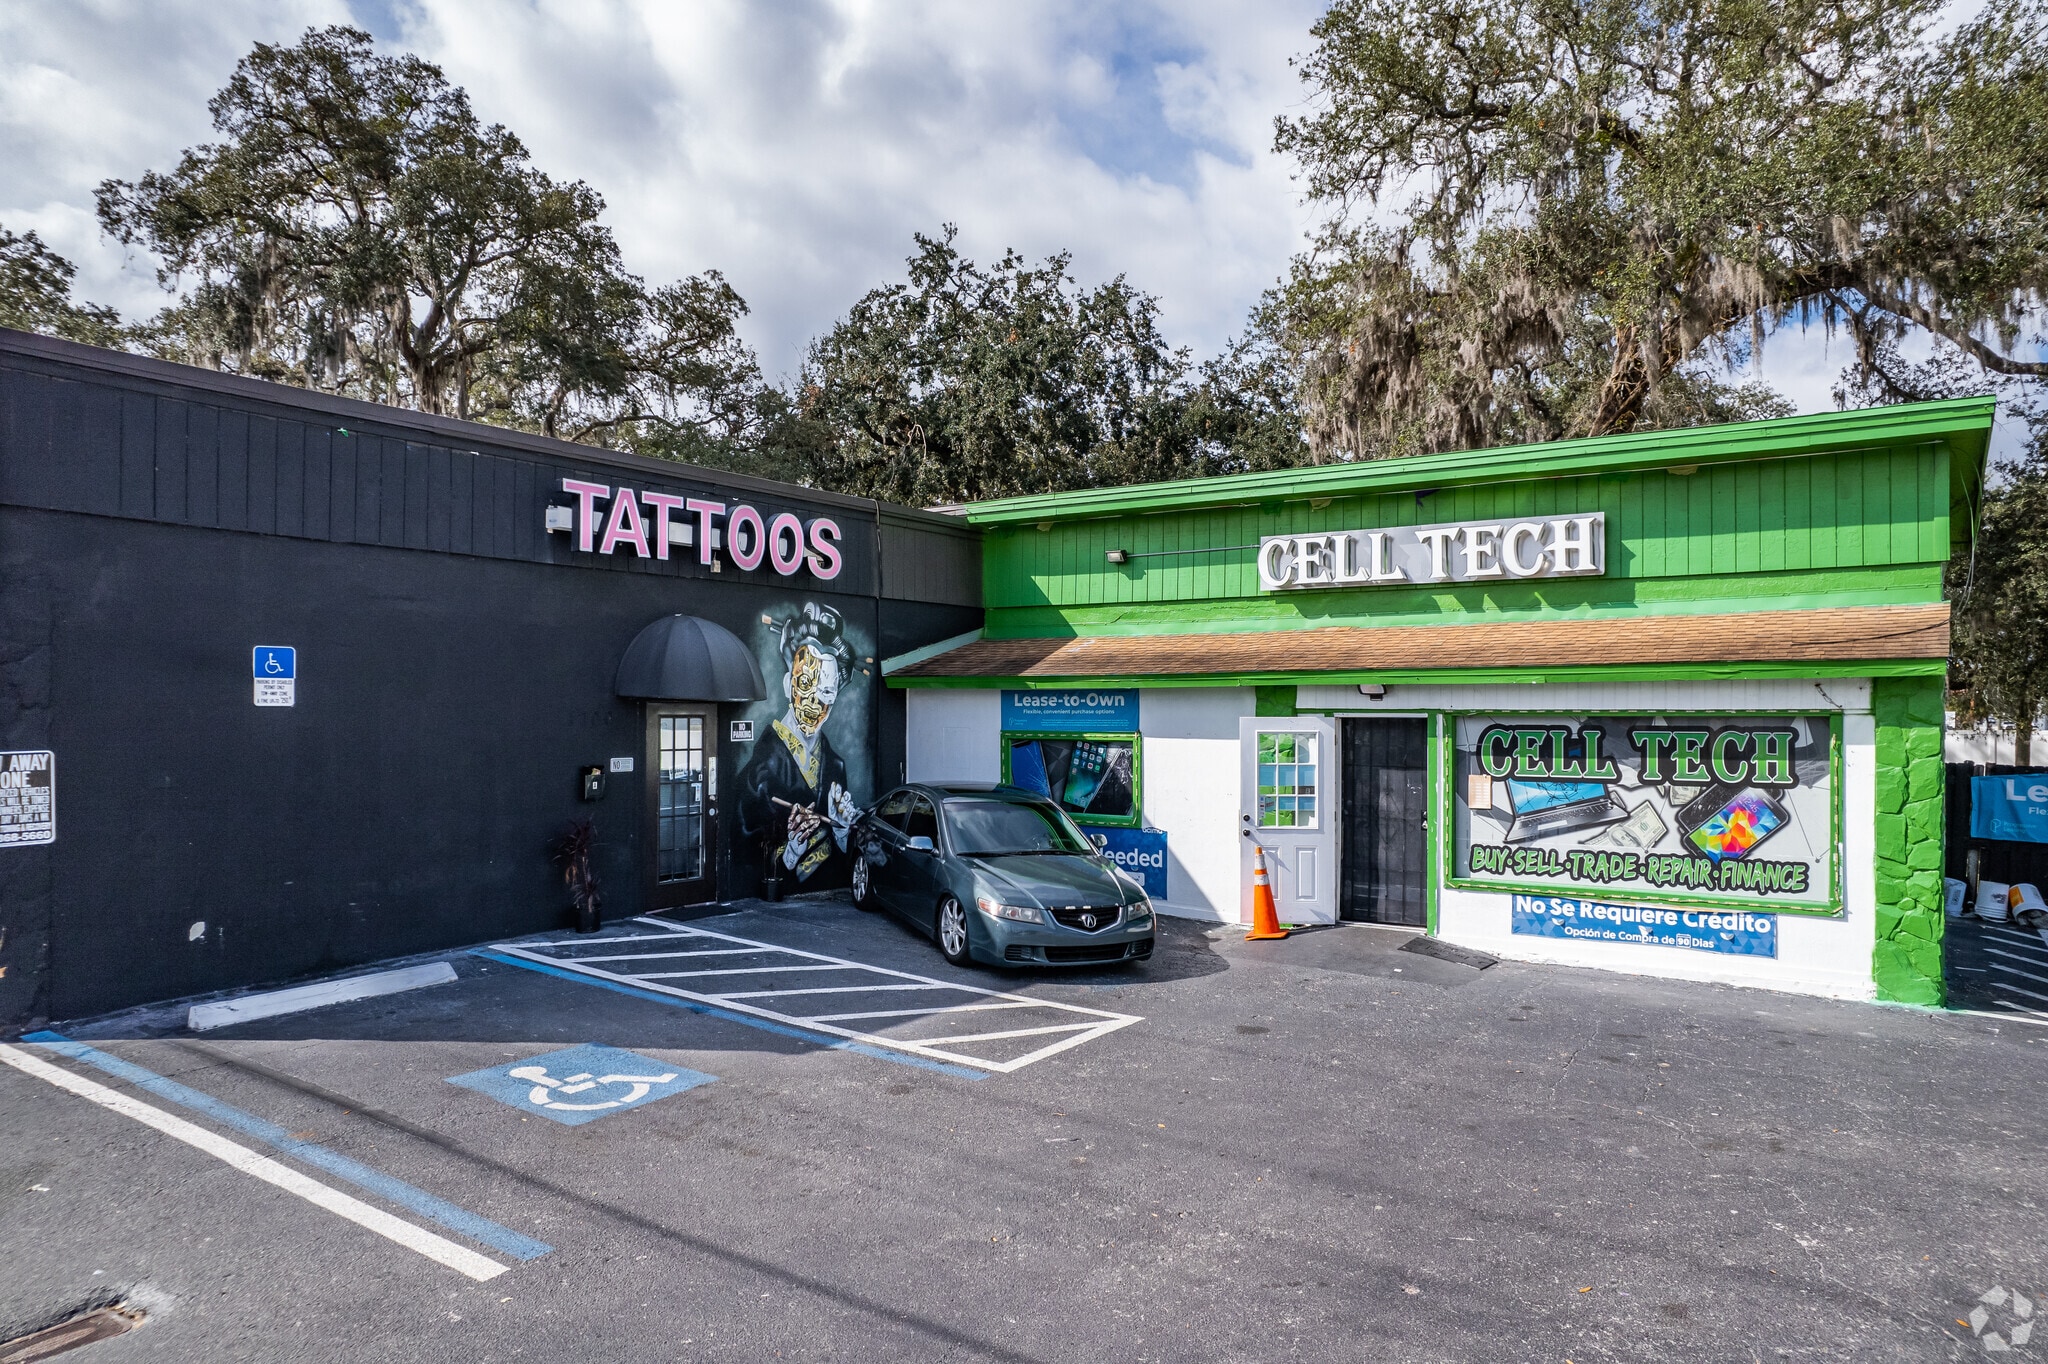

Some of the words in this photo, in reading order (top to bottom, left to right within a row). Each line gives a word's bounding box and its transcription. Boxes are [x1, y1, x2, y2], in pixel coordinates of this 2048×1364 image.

[562, 478, 842, 580] TATTOOS
[1257, 534, 1407, 587] CELL
[1415, 517, 1600, 579] TECH
[1014, 693, 1125, 707] Lease-to-Own
[733, 730, 751, 738] PARKING
[739, 723, 746, 731] NO
[9, 753, 49, 772] AWAY
[613, 760, 621, 770] NO
[1480, 729, 1617, 780] CELL
[1632, 731, 1794, 784] TECH
[2028, 806, 2048, 816] Fle
[1472, 848, 1507, 870] BUY
[1514, 850, 1564, 875] SELL
[1569, 852, 1636, 881] TRADE
[1647, 855, 1713, 887] REPAIR
[1721, 860, 1809, 892] FINANCE
[1516, 895, 1546, 914] No
[1550, 898, 1575, 917] Se
[1580, 901, 1678, 926] Requiere
[1564, 926, 1601, 937] Opción
[1602, 930, 1616, 939] de
[1618, 931, 1659, 944] Compra
[1661, 934, 1675, 945] de
[1677, 937, 1690, 946] 90
